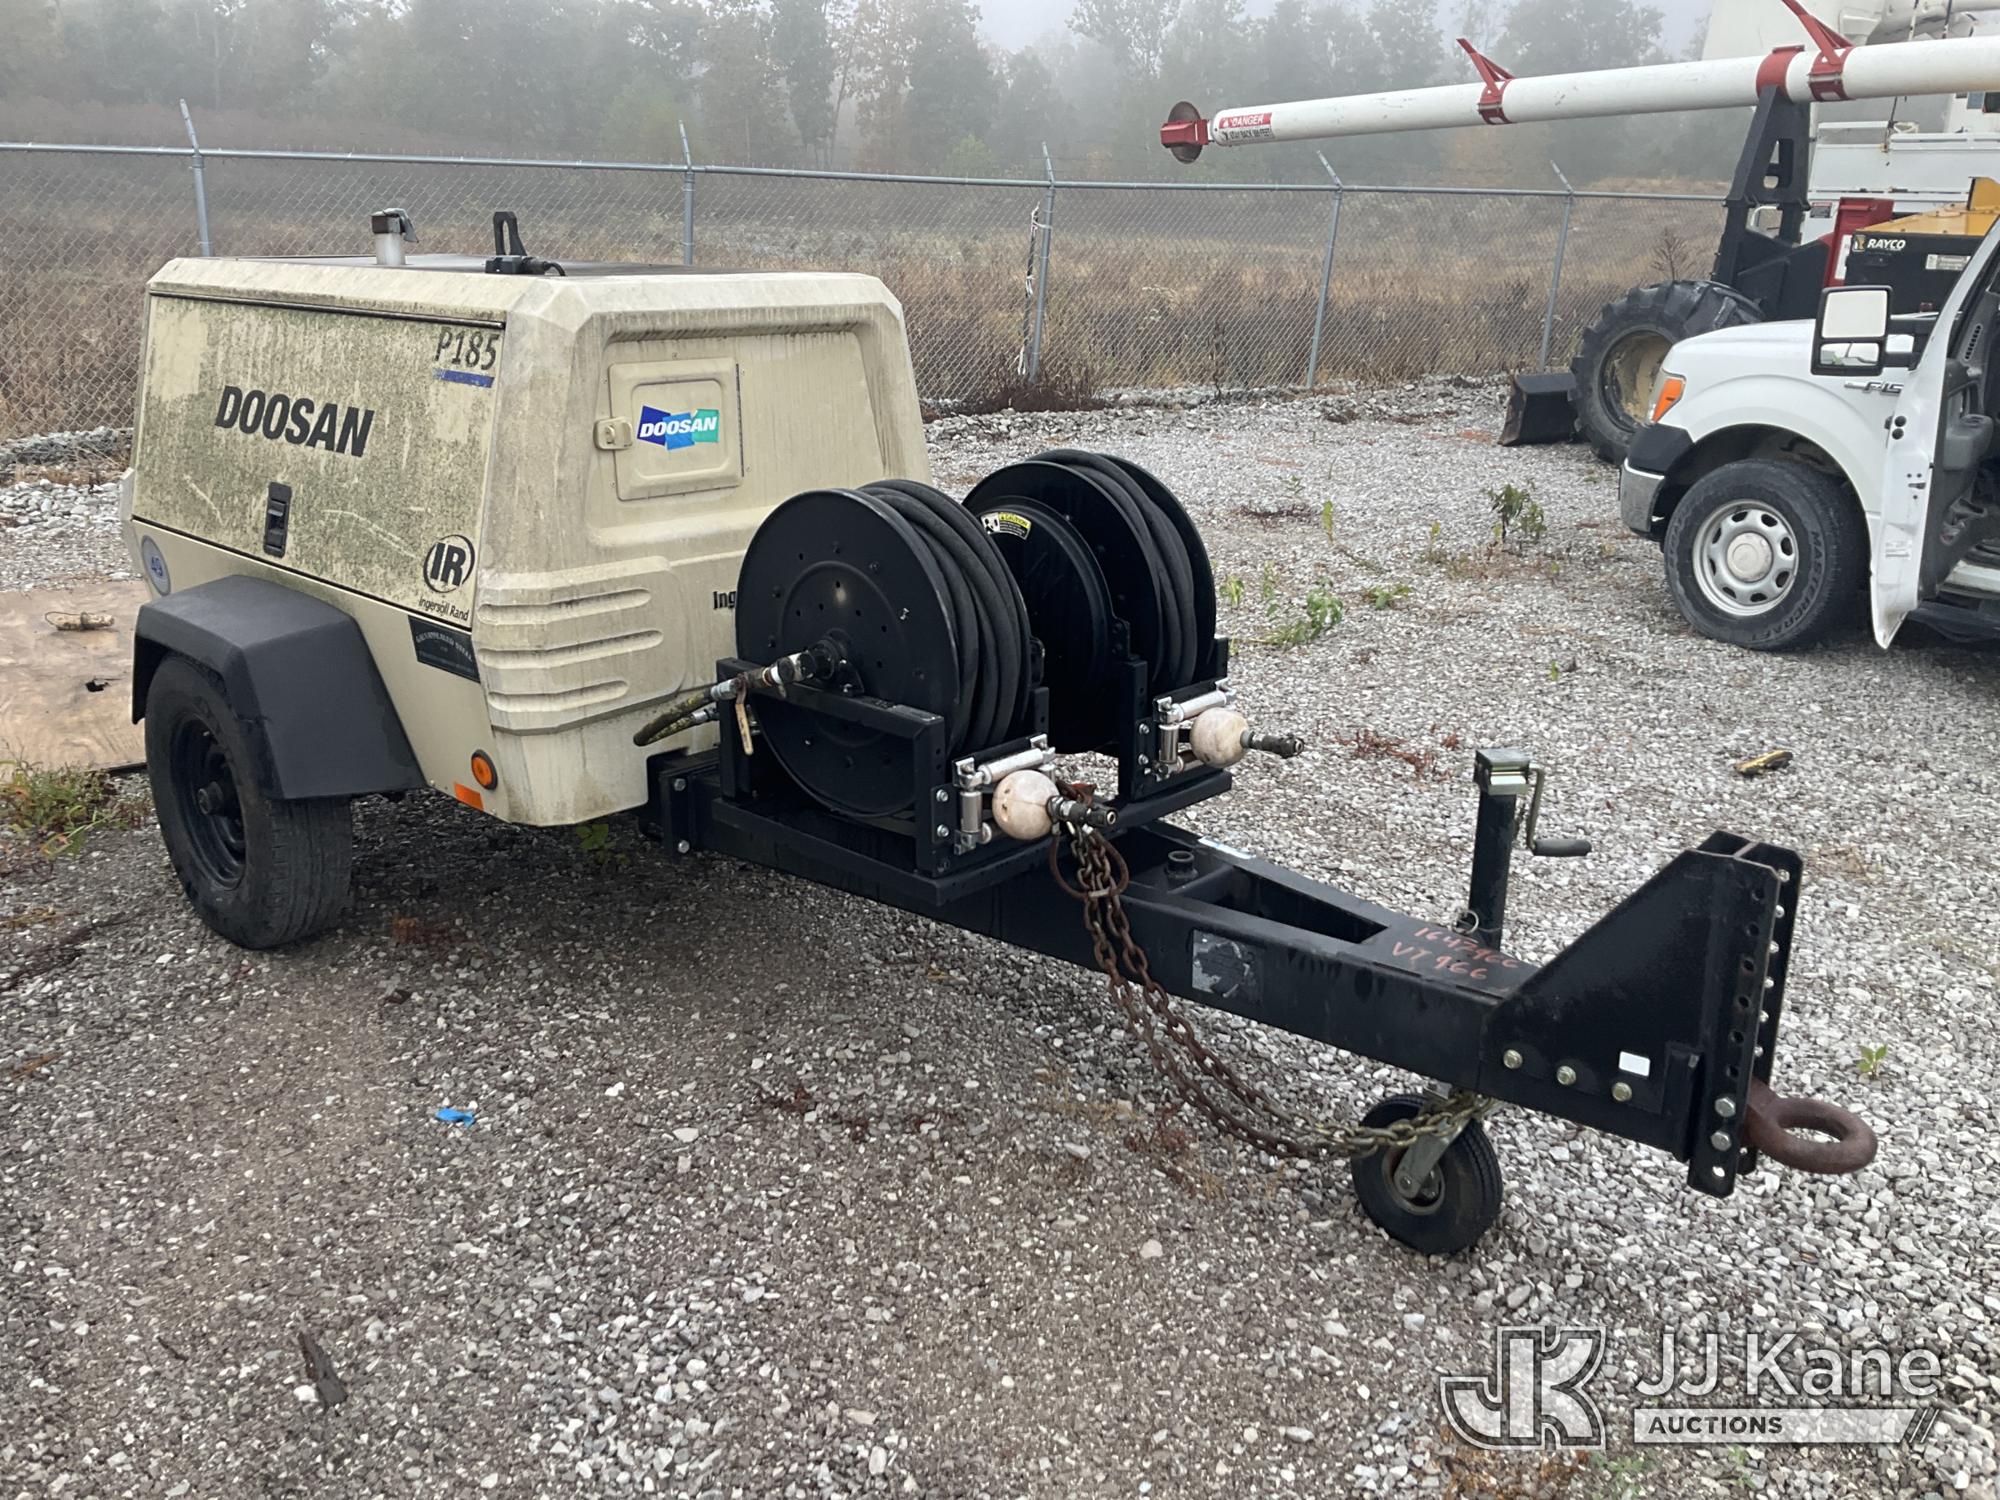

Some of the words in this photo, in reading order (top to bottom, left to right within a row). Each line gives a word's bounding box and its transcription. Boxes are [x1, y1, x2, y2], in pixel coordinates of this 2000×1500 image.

[1231, 114, 1264, 127] DANGER
[1866, 238, 1907, 250] RAYCO
[434, 326, 500, 371] P185
[1862, 381, 1904, 395] F-15
[215, 385, 375, 458] DOOSAN
[640, 416, 718, 438] DOOSAN
[430, 542, 466, 587] IR
[418, 595, 451, 615] Ingersoll
[450, 605, 470, 622] Rand
[713, 591, 736, 610] Ing
